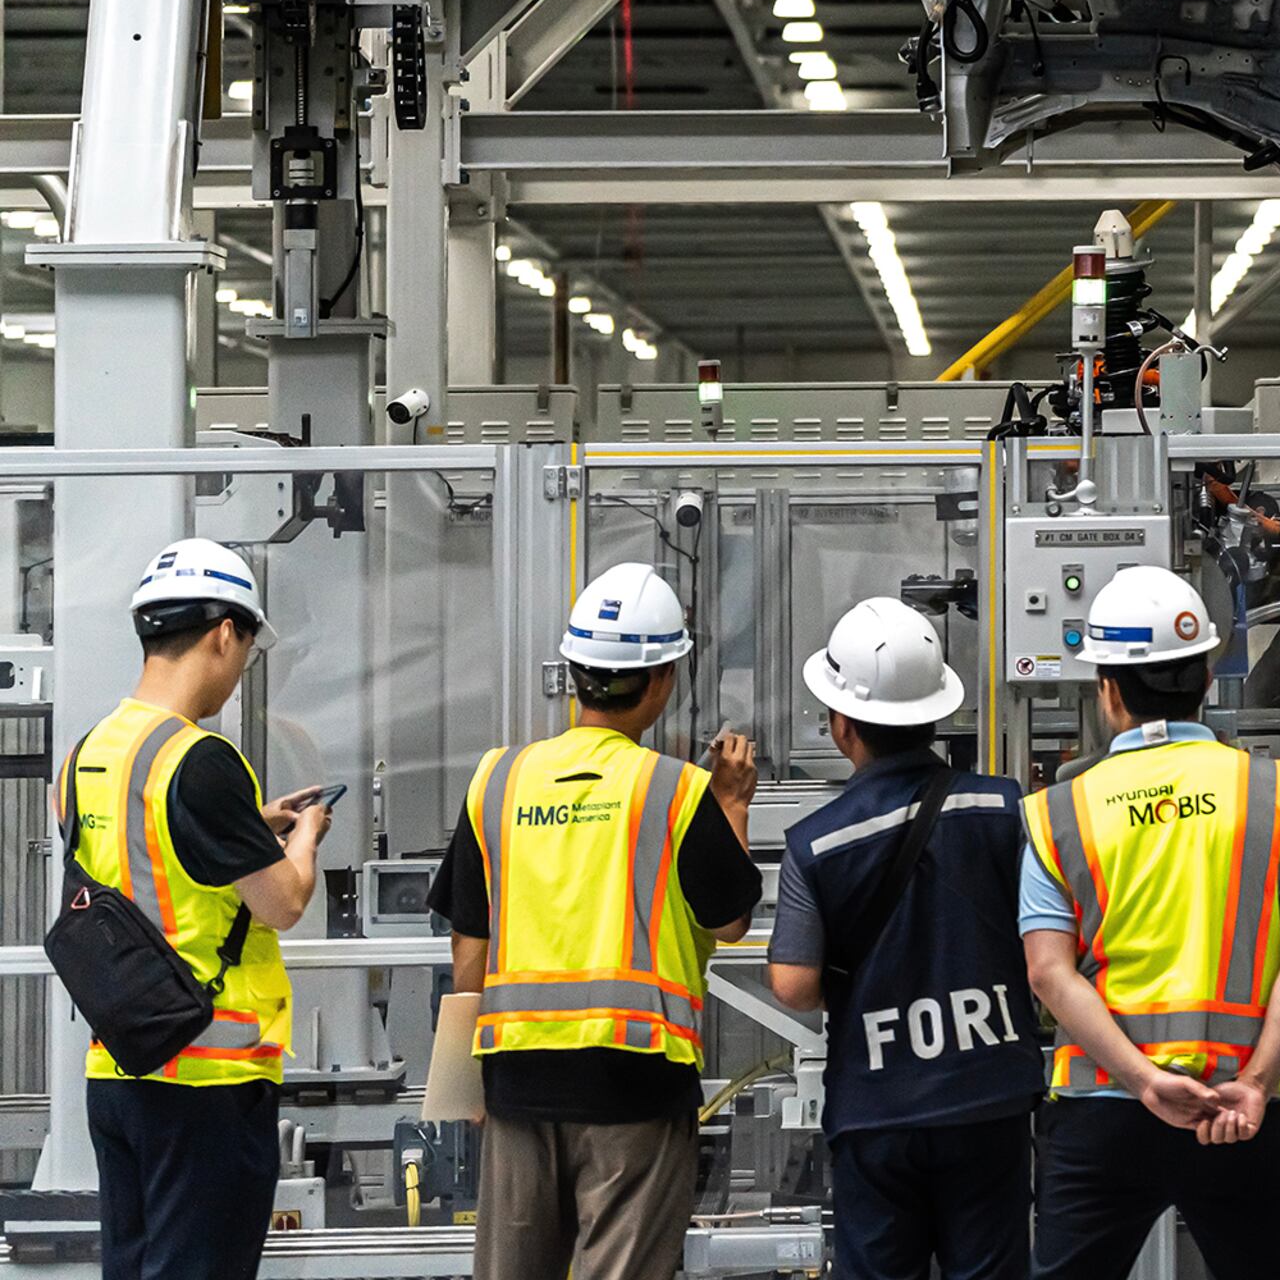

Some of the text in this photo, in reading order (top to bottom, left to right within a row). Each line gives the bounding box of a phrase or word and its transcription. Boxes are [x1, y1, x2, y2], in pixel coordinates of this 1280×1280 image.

[1059, 532, 1073, 542] CM
[1077, 532, 1099, 542] GATE
[1102, 532, 1121, 542] BOX
[1105, 784, 1175, 807] HYUNDAI
[516, 800, 622, 826] HMG Metaplant
[571, 813, 612, 824] America
[1127, 792, 1218, 827] MOBIS
[861, 984, 1020, 1071] FORI
